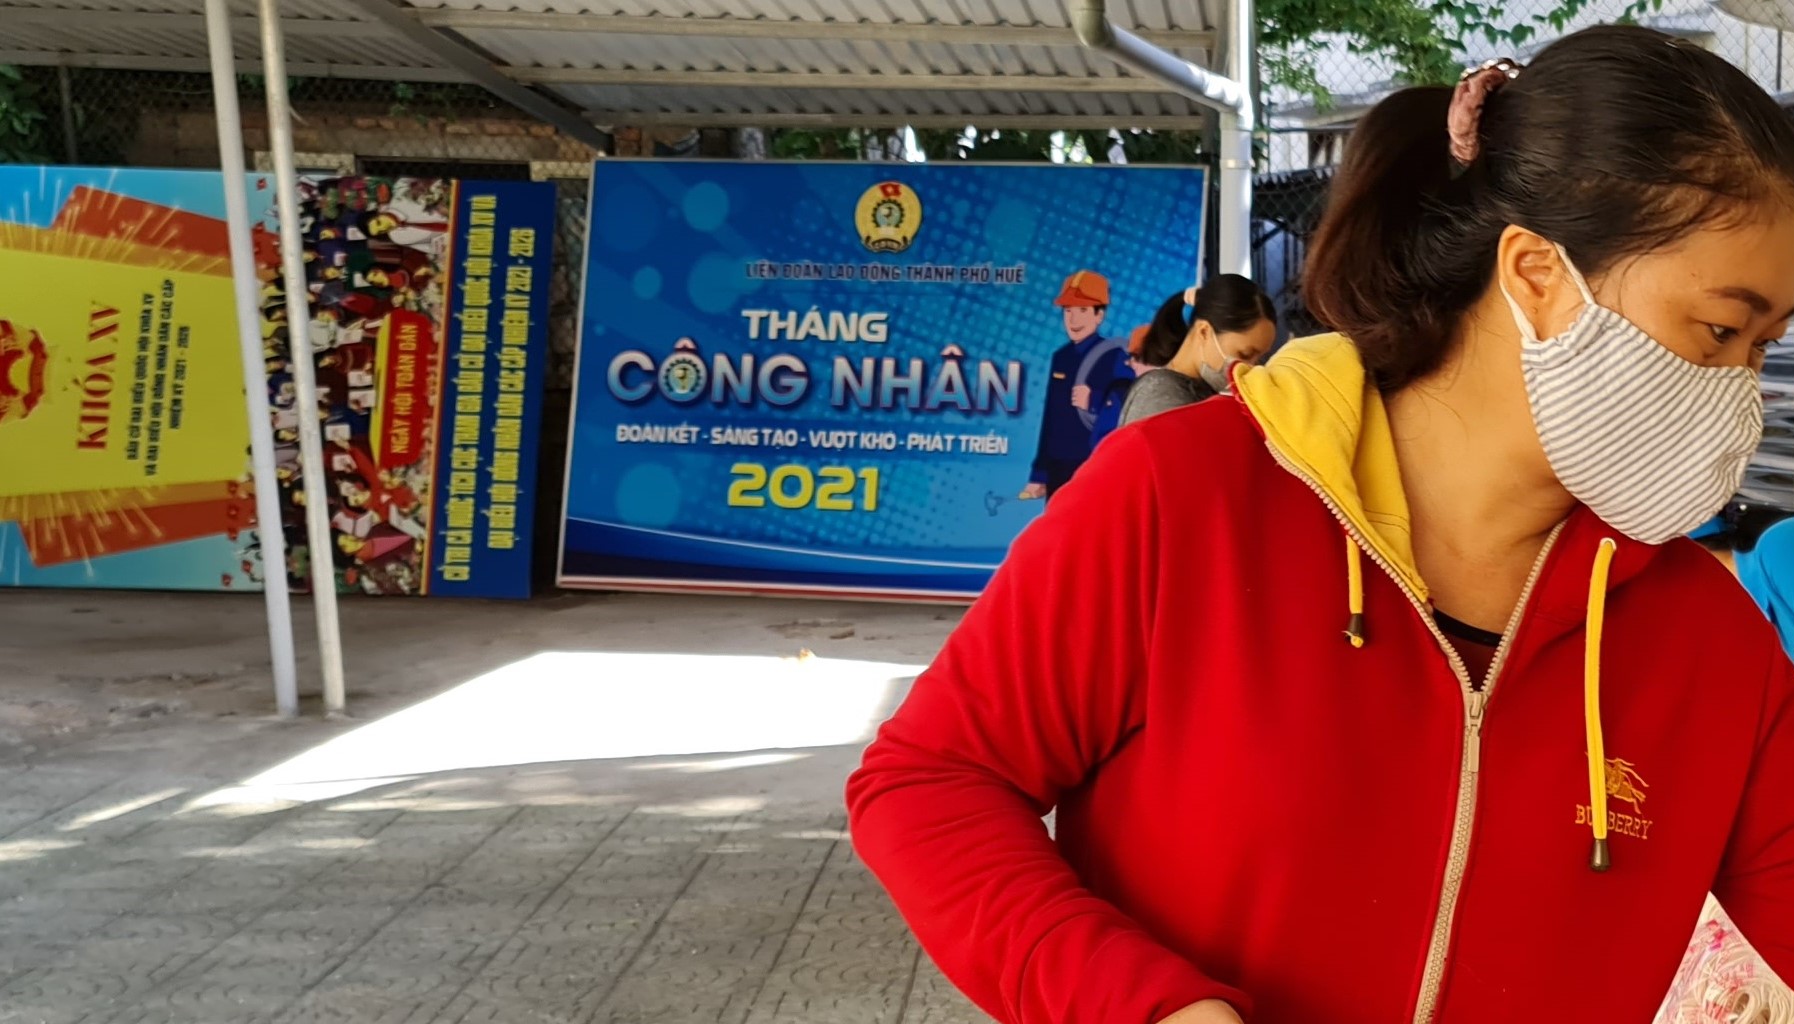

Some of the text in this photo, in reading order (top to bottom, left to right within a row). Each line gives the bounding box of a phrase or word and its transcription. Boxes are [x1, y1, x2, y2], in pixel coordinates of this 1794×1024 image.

[507, 228, 535, 257] 2026
[505, 266, 532, 292] 2021
[741, 306, 889, 343] THÁNG
[73, 301, 120, 450] KHÓA XV
[606, 337, 1021, 413] CÔNG NHÂN
[389, 419, 410, 454] NGÀY
[762, 429, 798, 450] TẠO
[727, 462, 880, 511] 2021
[1575, 804, 1653, 839] BUBERRY
